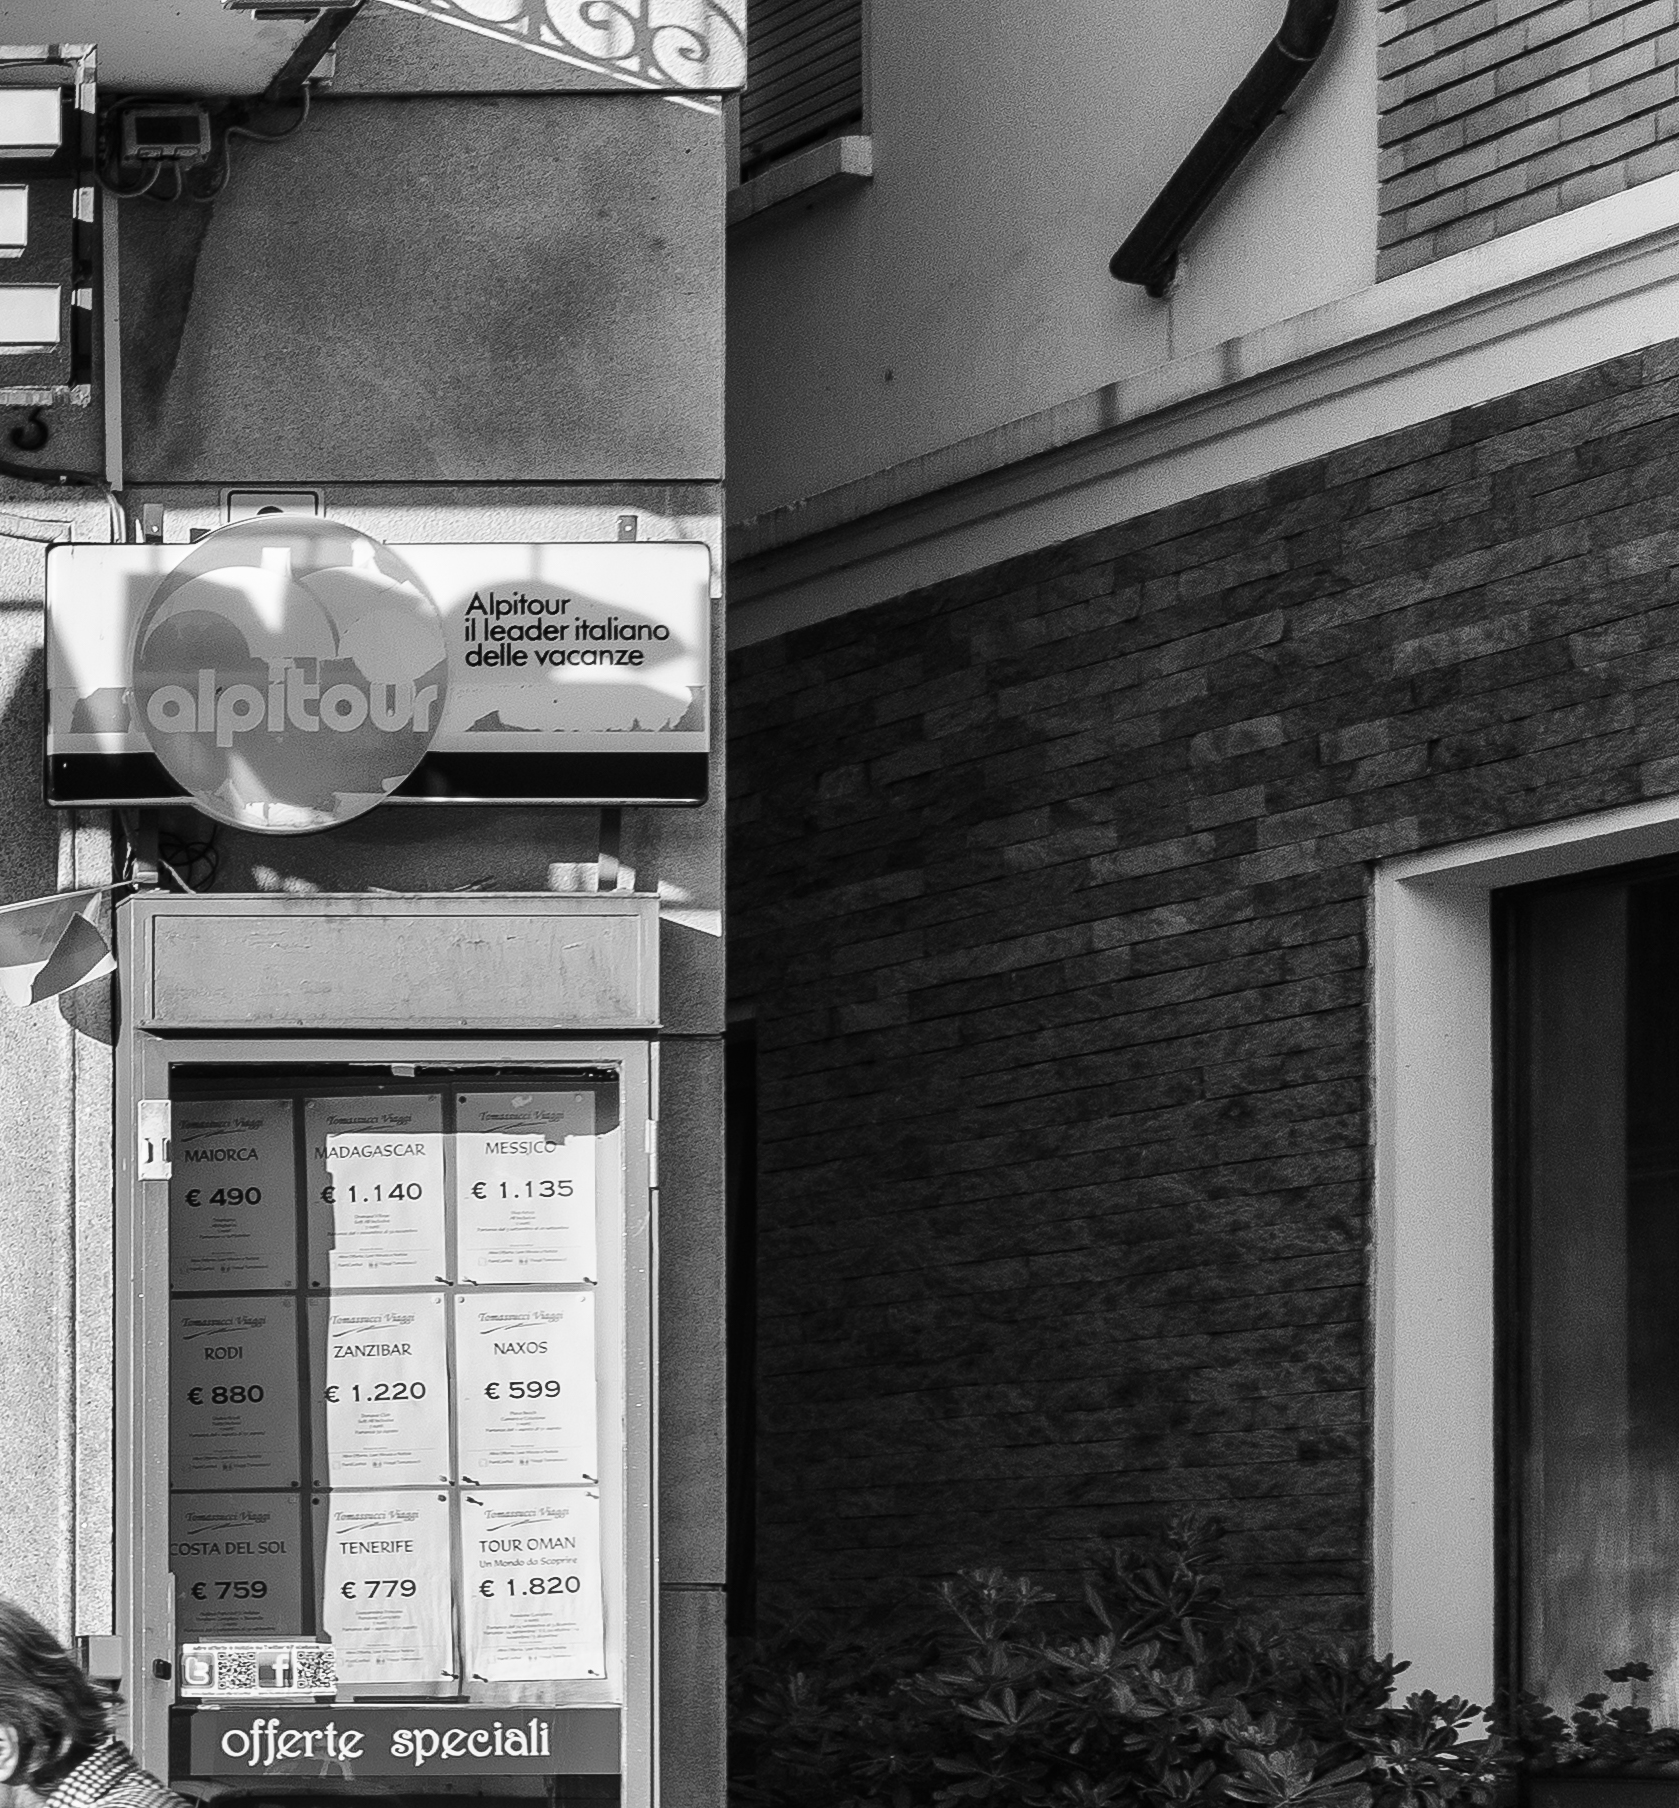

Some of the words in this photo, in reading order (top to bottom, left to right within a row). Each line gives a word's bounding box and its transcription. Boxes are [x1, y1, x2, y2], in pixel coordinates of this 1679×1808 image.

[464, 591, 572, 621] Alpitour
[465, 618, 478, 642] il
[483, 618, 569, 642] leader
[574, 618, 670, 642] italiano
[465, 643, 530, 668] delle
[534, 648, 645, 668] vacanze
[145, 657, 438, 748] alpitour
[184, 1148, 259, 1163] MAIORCA
[314, 1143, 426, 1160] MADAGASCAR
[485, 1140, 557, 1155] MESSICO
[185, 1188, 201, 1208] €
[209, 1186, 262, 1207] 490
[320, 1186, 337, 1205] €
[348, 1182, 423, 1204] 1.140
[471, 1182, 487, 1200] €
[499, 1180, 574, 1199] 1.135
[204, 1346, 243, 1360] RODI
[333, 1343, 412, 1358] ZANZIBAR
[493, 1341, 549, 1356] NAXOS
[187, 1387, 204, 1406] €
[211, 1384, 265, 1404] 880
[324, 1385, 340, 1404] €
[352, 1381, 427, 1402] 1.220
[484, 1382, 501, 1401] €
[509, 1380, 562, 1399] 599
[170, 1541, 220, 1557] COSTA
[224, 1541, 254, 1556] DEL
[257, 1540, 287, 1555] SOL
[340, 1540, 414, 1556] TENERIFE
[479, 1538, 523, 1553] TOUR
[527, 1536, 577, 1551] OMAN
[479, 1559, 492, 1568] Un
[494, 1558, 524, 1567] Mondo
[540, 1556, 578, 1568] Scoprire
[191, 1582, 207, 1601] €
[214, 1580, 268, 1599] 759
[340, 1581, 357, 1599] €
[367, 1579, 417, 1599] 779
[479, 1579, 496, 1598] €
[507, 1576, 581, 1597] 1.820
[221, 1718, 364, 1767] offerte
[390, 1719, 551, 1767] speciali
